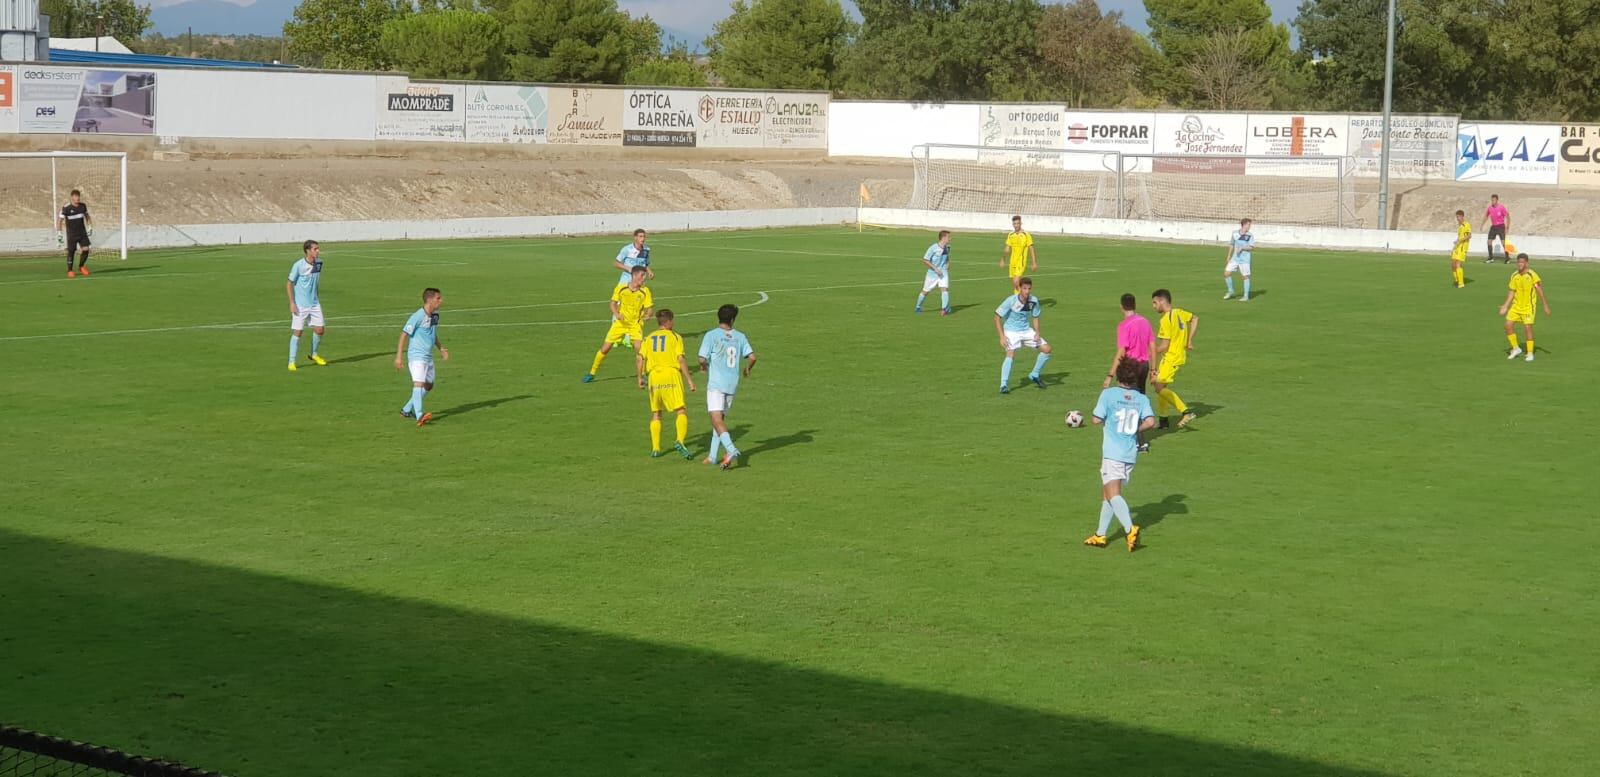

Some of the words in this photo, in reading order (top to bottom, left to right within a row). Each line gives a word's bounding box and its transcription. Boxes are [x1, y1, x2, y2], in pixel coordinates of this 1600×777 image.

[390, 97, 451, 111] MOMPRADE
[777, 103, 819, 116] LANUZA
[557, 113, 605, 132] Samuel
[638, 110, 695, 128] BARREÑA
[1008, 112, 1060, 123] ortopedia
[1091, 125, 1149, 139] FOPRAR
[1254, 126, 1337, 138] LOBERA
[1561, 126, 1585, 138] BAR
[1461, 135, 1555, 162] AZAL
[651, 335, 666, 352] 11
[726, 346, 737, 368] 8
[1115, 408, 1140, 435] 10
